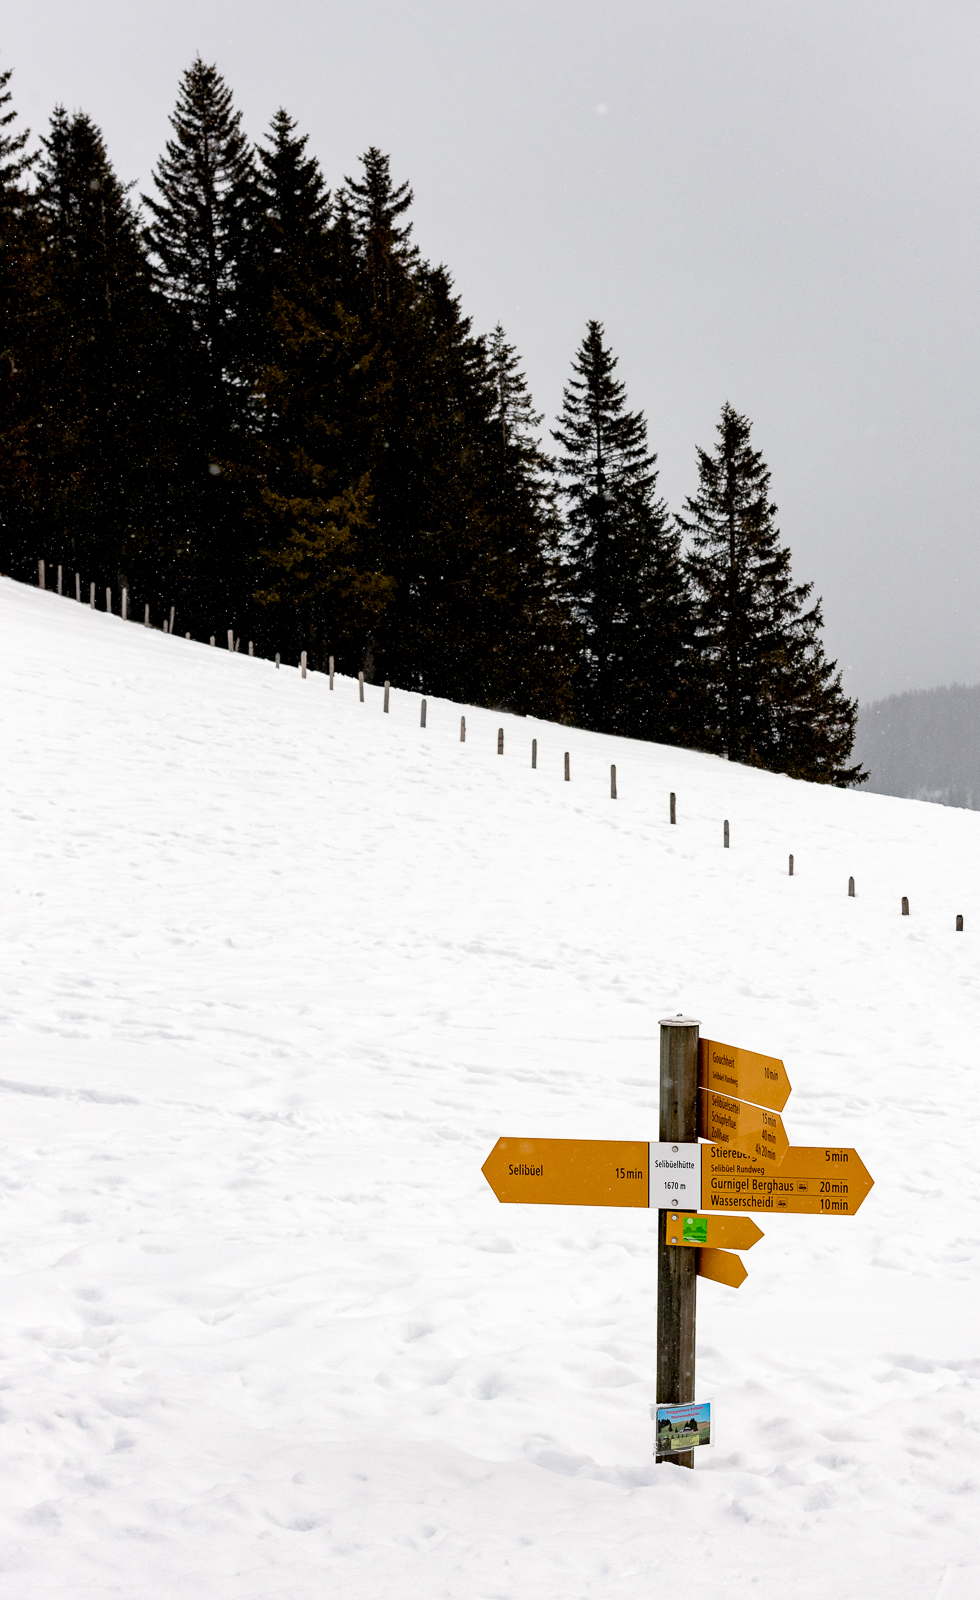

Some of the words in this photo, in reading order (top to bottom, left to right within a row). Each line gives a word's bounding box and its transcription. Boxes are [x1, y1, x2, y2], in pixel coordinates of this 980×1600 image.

[712, 1051, 735, 1069] Gouchheit
[711, 1094, 741, 1115] Selibüelsattel
[711, 1126, 730, 1143] Zollhaus
[508, 1164, 544, 1176] Selibüel
[654, 1159, 695, 1169] Selibüelhütte
[711, 1164, 735, 1173] Selibüel
[736, 1165, 765, 1176] Rundweg
[664, 1181, 679, 1190] 1670
[711, 1177, 749, 1192] Gurnigel
[752, 1179, 794, 1193] Berghaus
[711, 1194, 774, 1208] Wasserscheidi
